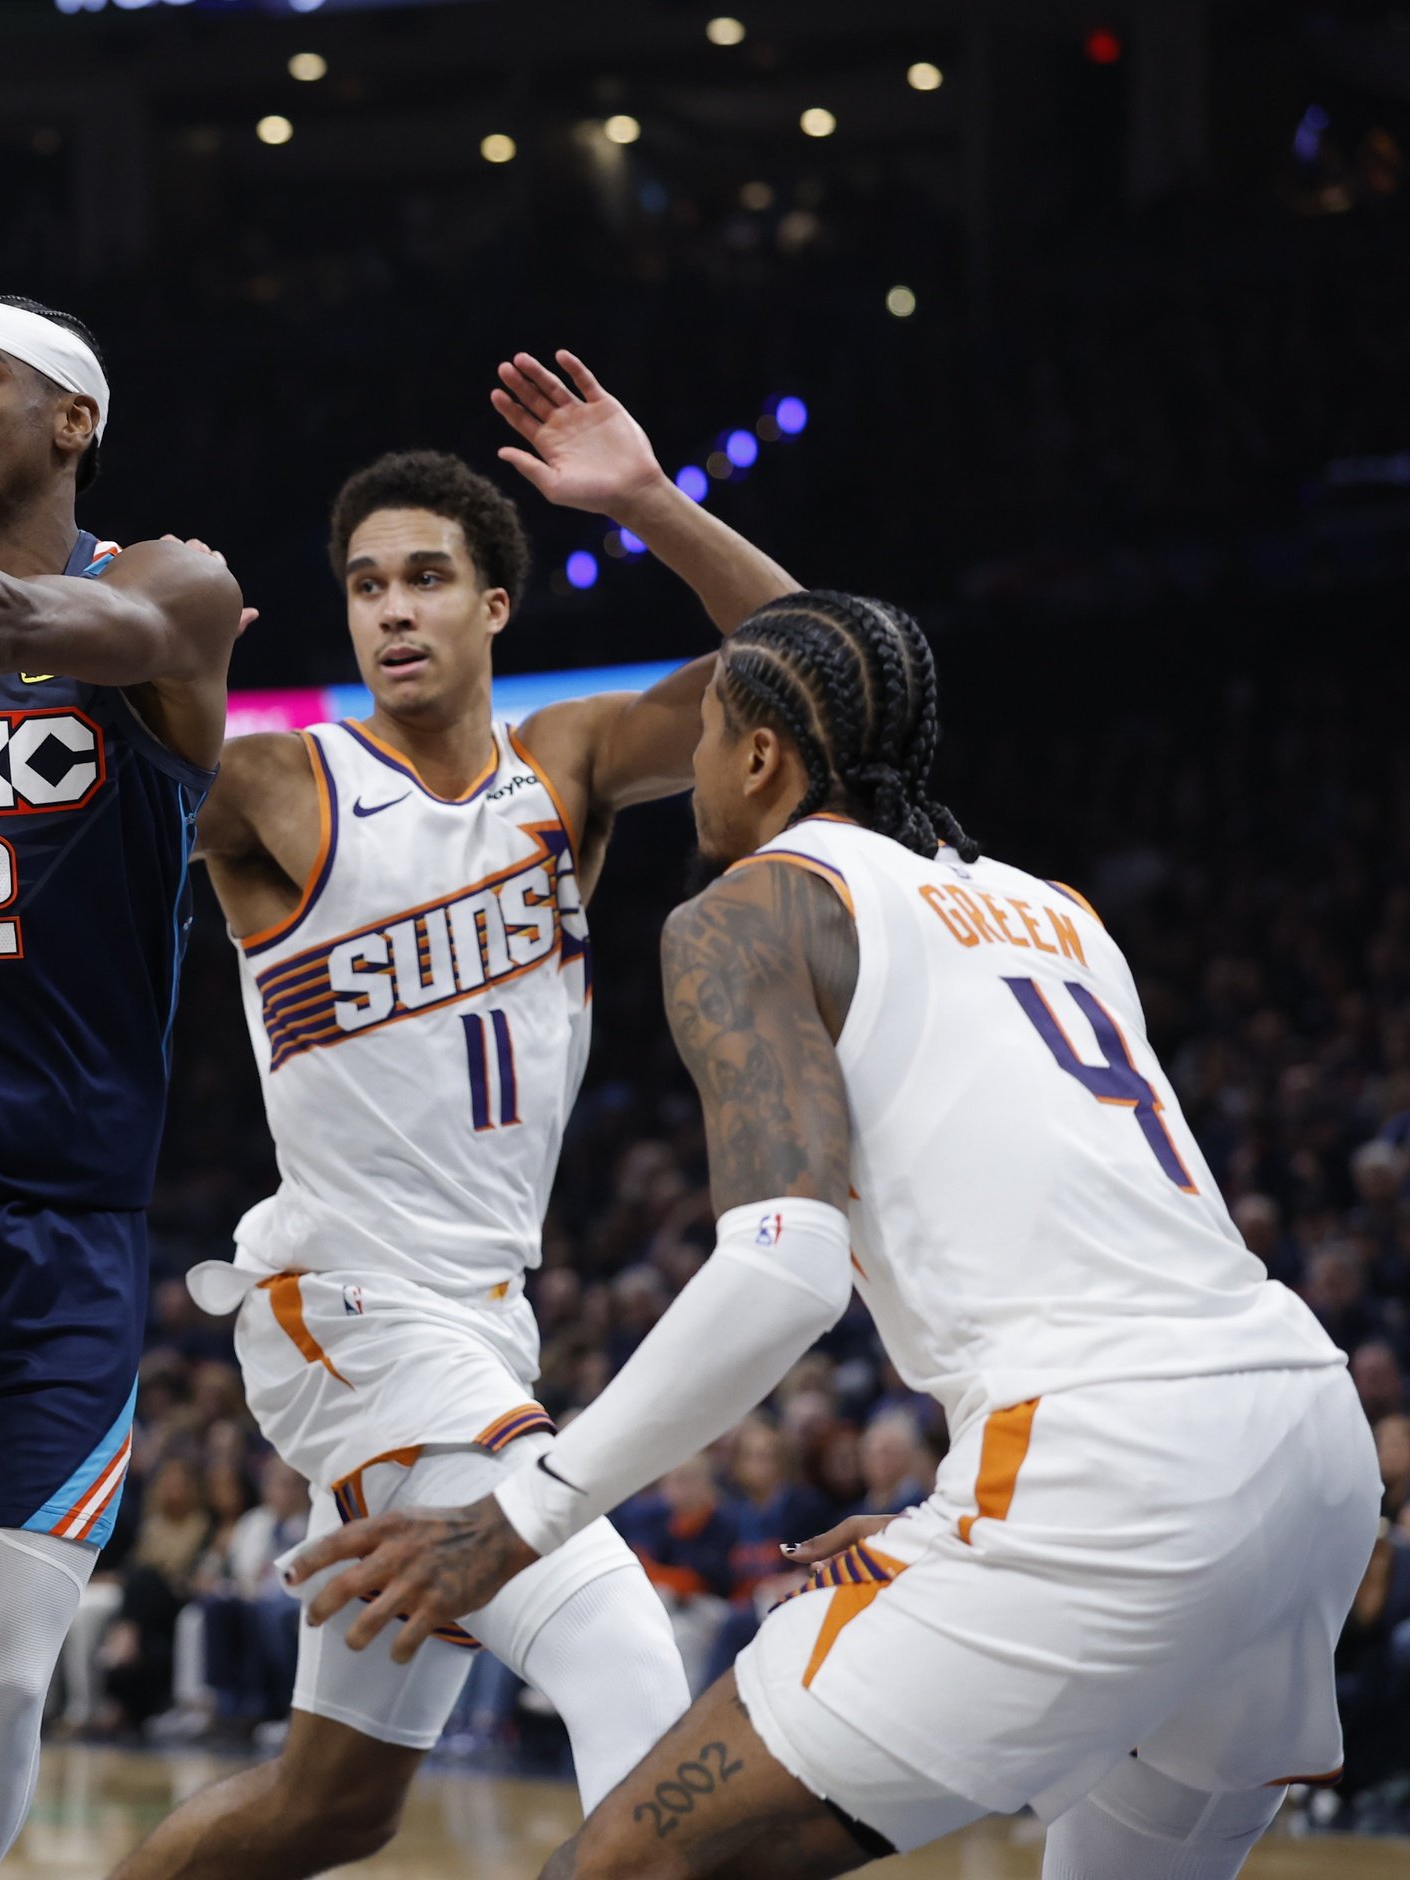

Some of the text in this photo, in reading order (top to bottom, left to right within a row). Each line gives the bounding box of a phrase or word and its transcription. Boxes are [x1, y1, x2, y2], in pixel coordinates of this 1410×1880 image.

[486, 775, 540, 801] ayPa
[328, 867, 556, 1032] SUNS
[918, 883, 1088, 969] GREEN
[459, 1009, 522, 1132] 11
[998, 975, 1200, 1196] 4
[633, 1741, 744, 1838] 2002
